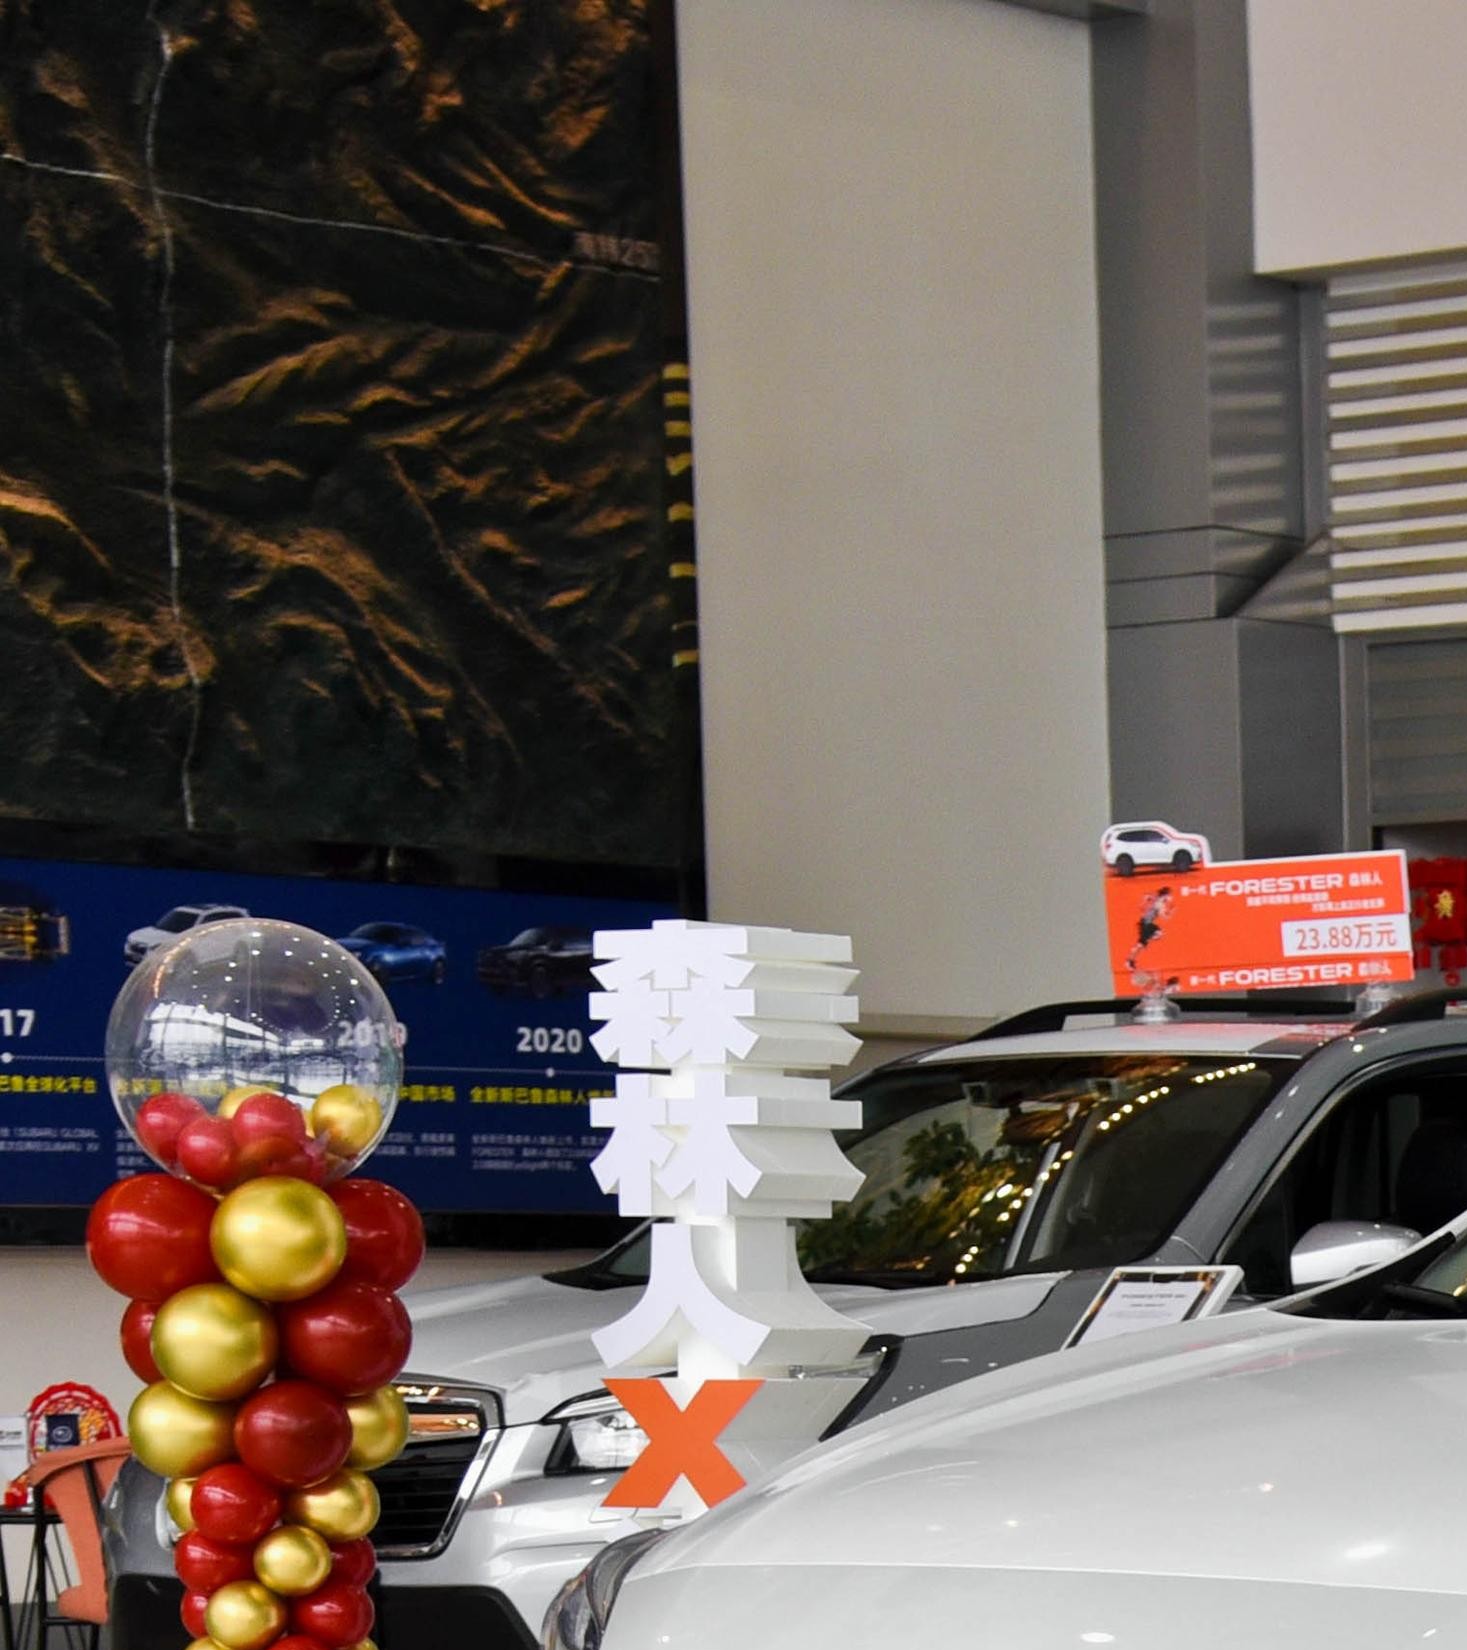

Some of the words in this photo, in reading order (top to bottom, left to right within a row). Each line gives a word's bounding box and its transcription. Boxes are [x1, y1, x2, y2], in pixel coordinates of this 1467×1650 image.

[1209, 873, 1344, 896] FORESTER
[1294, 922, 1397, 951] 23.88万元
[1218, 962, 1353, 986] FORESTER
[516, 1027, 583, 1053] 2020
[589, 919, 772, 1368] 森林人
